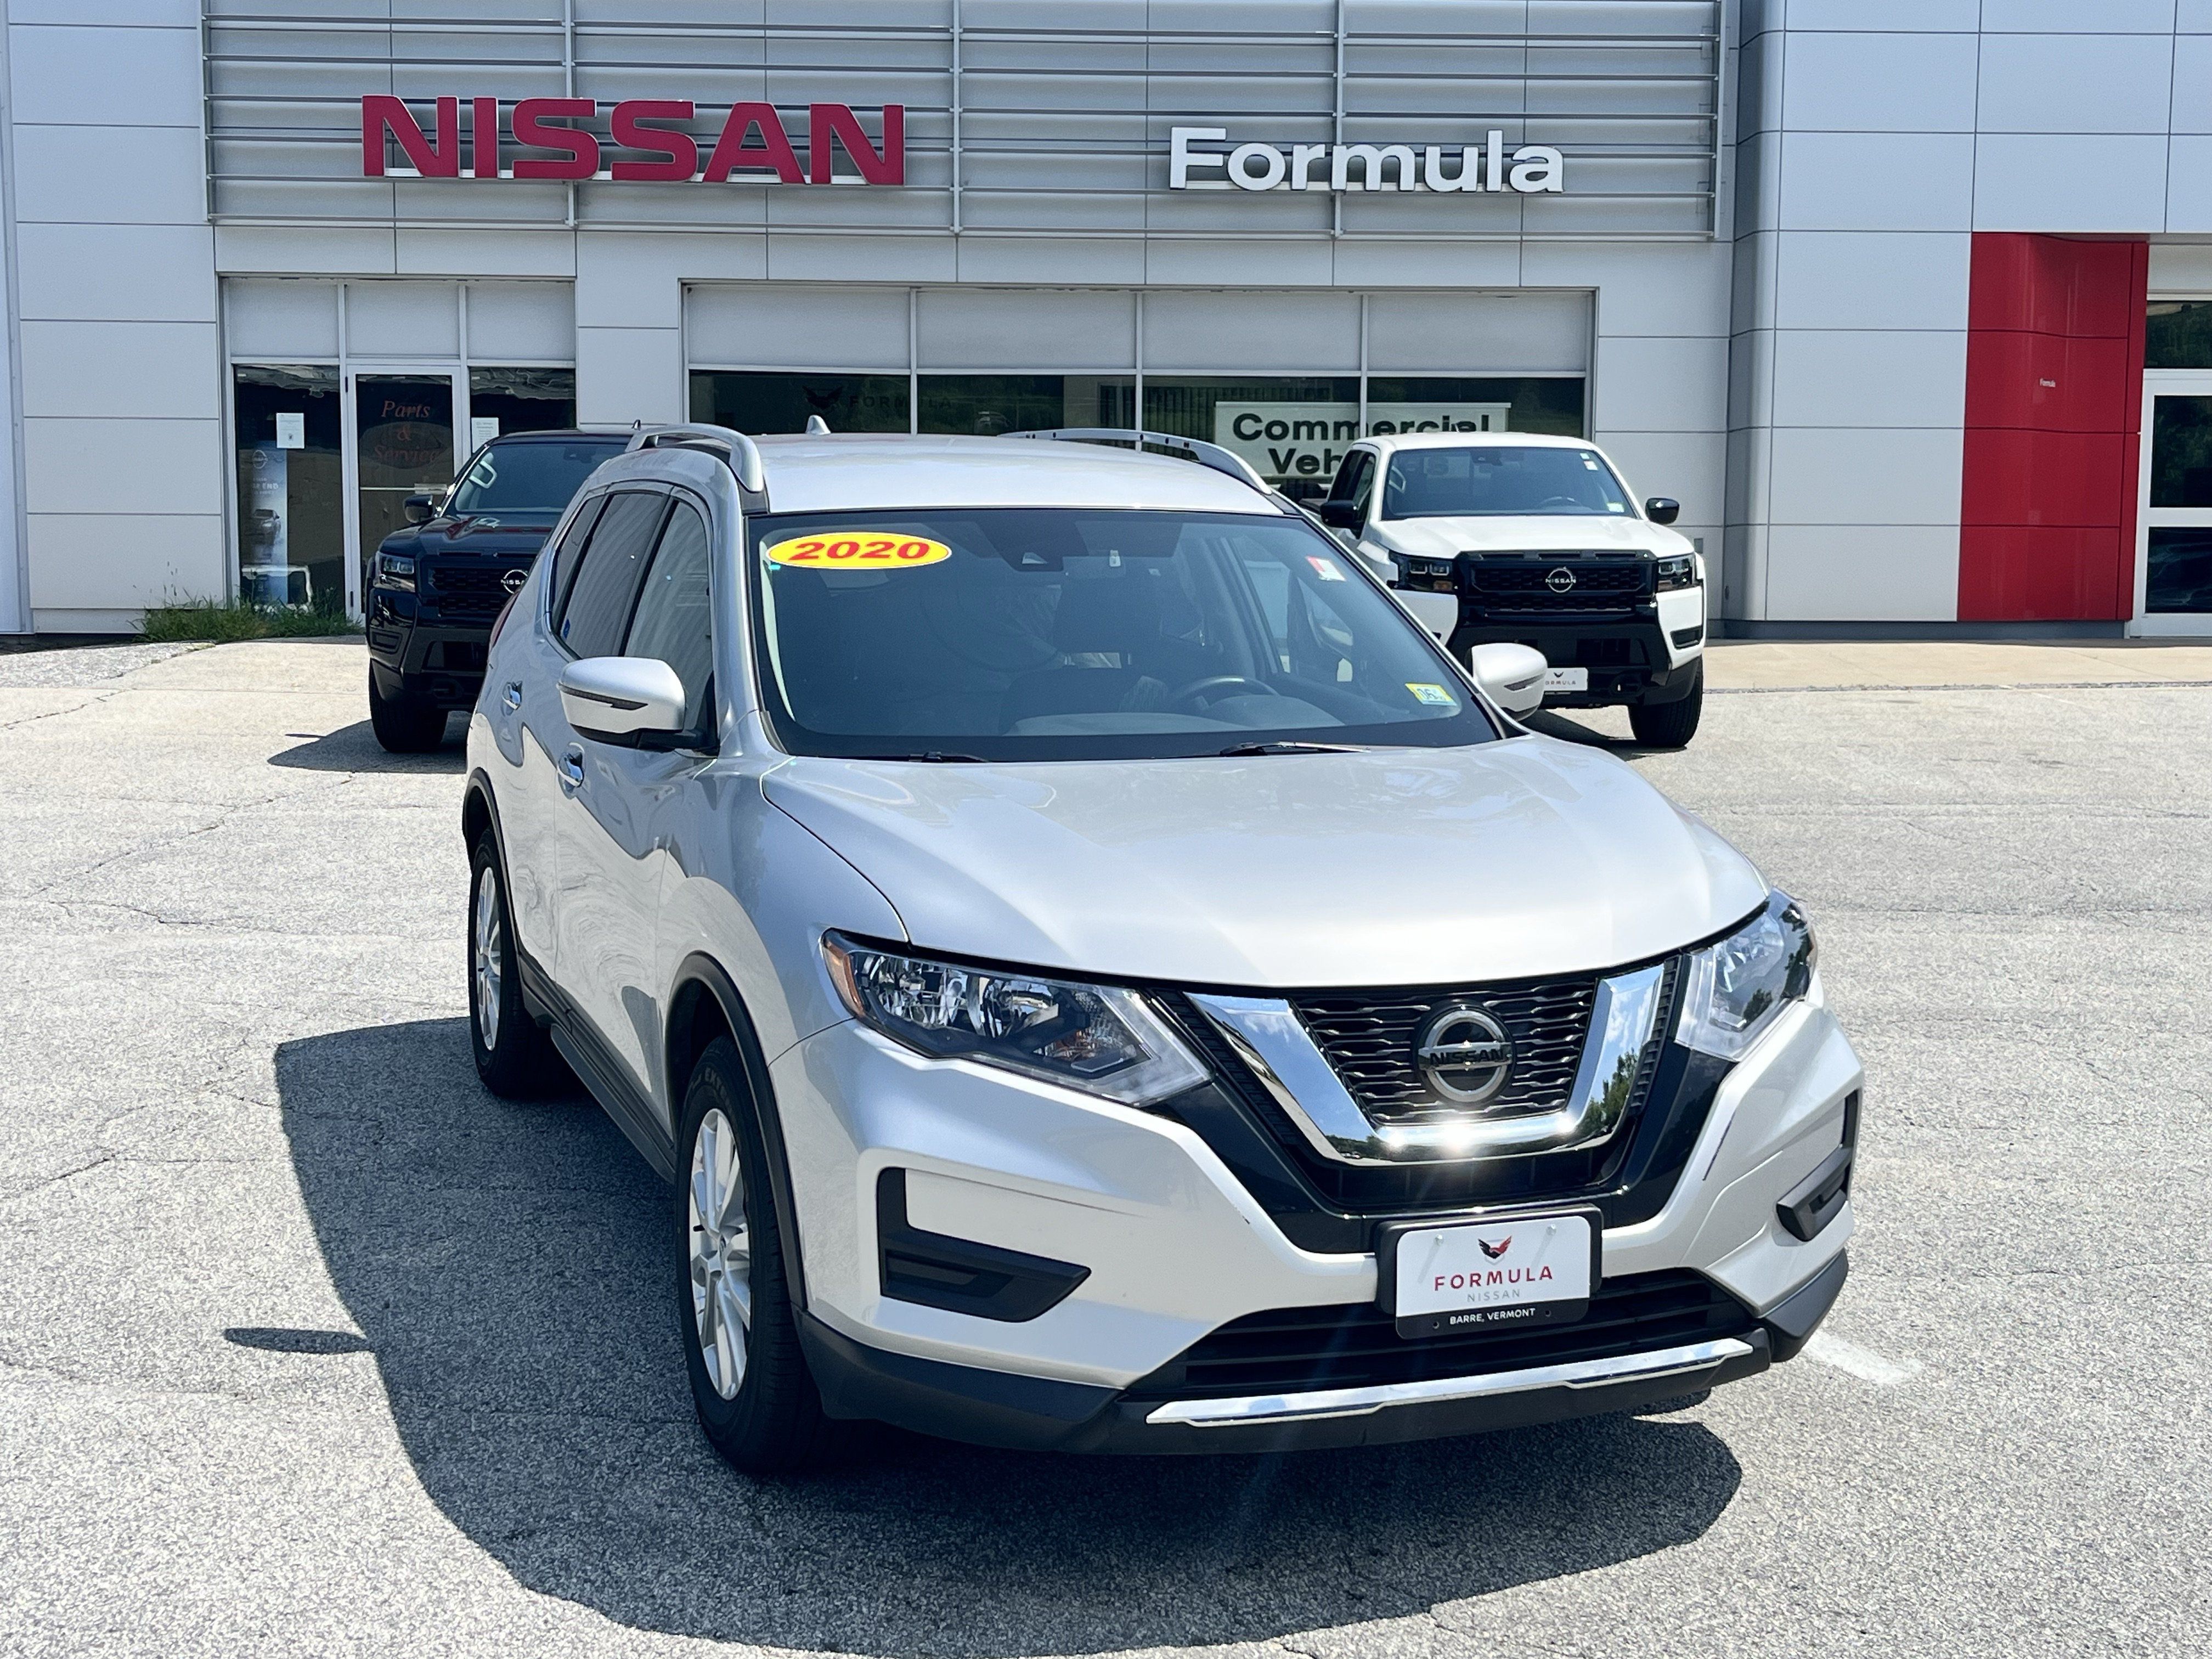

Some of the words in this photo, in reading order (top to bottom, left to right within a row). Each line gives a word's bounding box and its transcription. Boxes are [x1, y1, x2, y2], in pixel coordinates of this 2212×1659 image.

[363, 95, 905, 185] NISSAN
[1170, 126, 1564, 192] Formula
[381, 400, 430, 418] Parts
[397, 425, 411, 441] &
[1233, 413, 1489, 441] Commercial
[374, 444, 439, 462] Service
[788, 541, 930, 561] 2020
[1430, 1048, 1504, 1065] NISSAN
[1435, 1266, 1553, 1291] FORMULA
[1467, 1289, 1521, 1302] NISSAN
[1487, 1308, 1536, 1321] VERMONT
